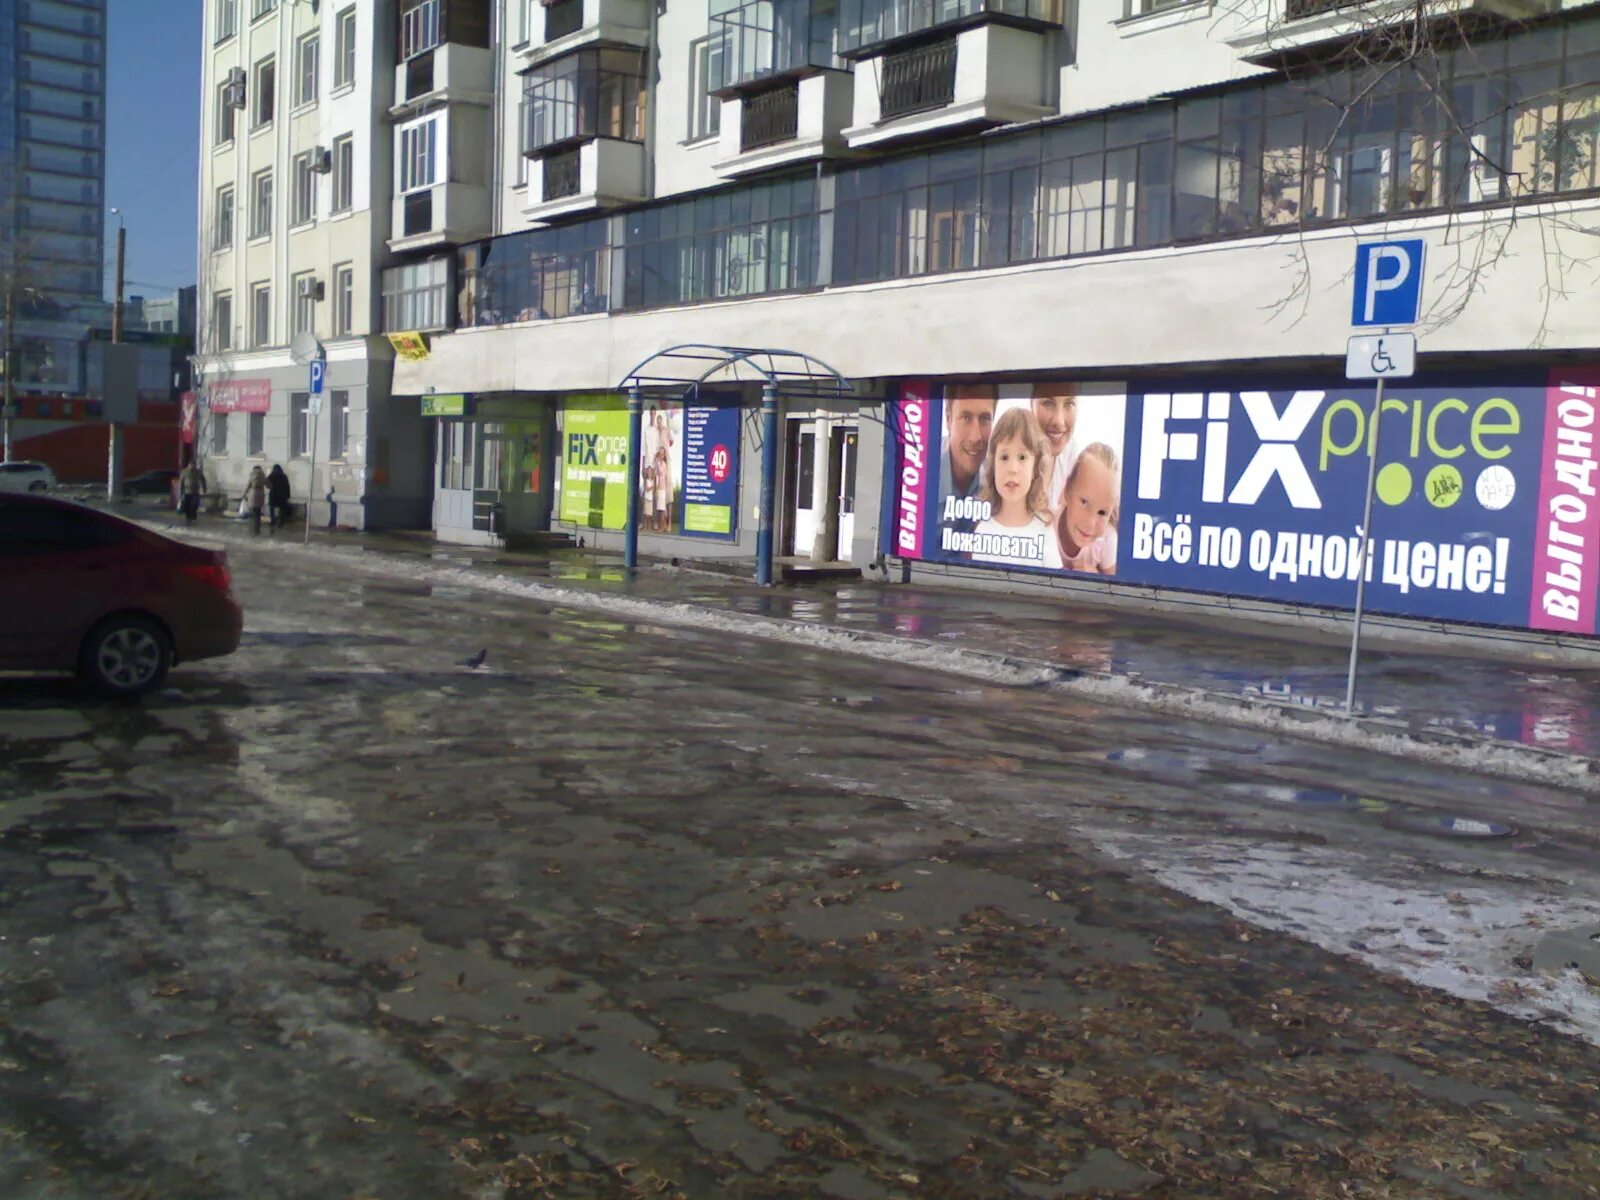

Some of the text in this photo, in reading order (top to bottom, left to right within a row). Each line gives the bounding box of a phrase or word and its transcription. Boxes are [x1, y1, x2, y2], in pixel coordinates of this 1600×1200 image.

[1363, 245, 1411, 322] P
[711, 451, 727, 470] 40
[898, 391, 924, 552] ВЫГОДНО!
[1318, 397, 1521, 472] price
[943, 495, 992, 522] Добро
[1542, 380, 1598, 622] ВЫГОДНО!
[942, 527, 1045, 560] Пожаловать!
[1132, 512, 1511, 595] Всё по одной цене!
